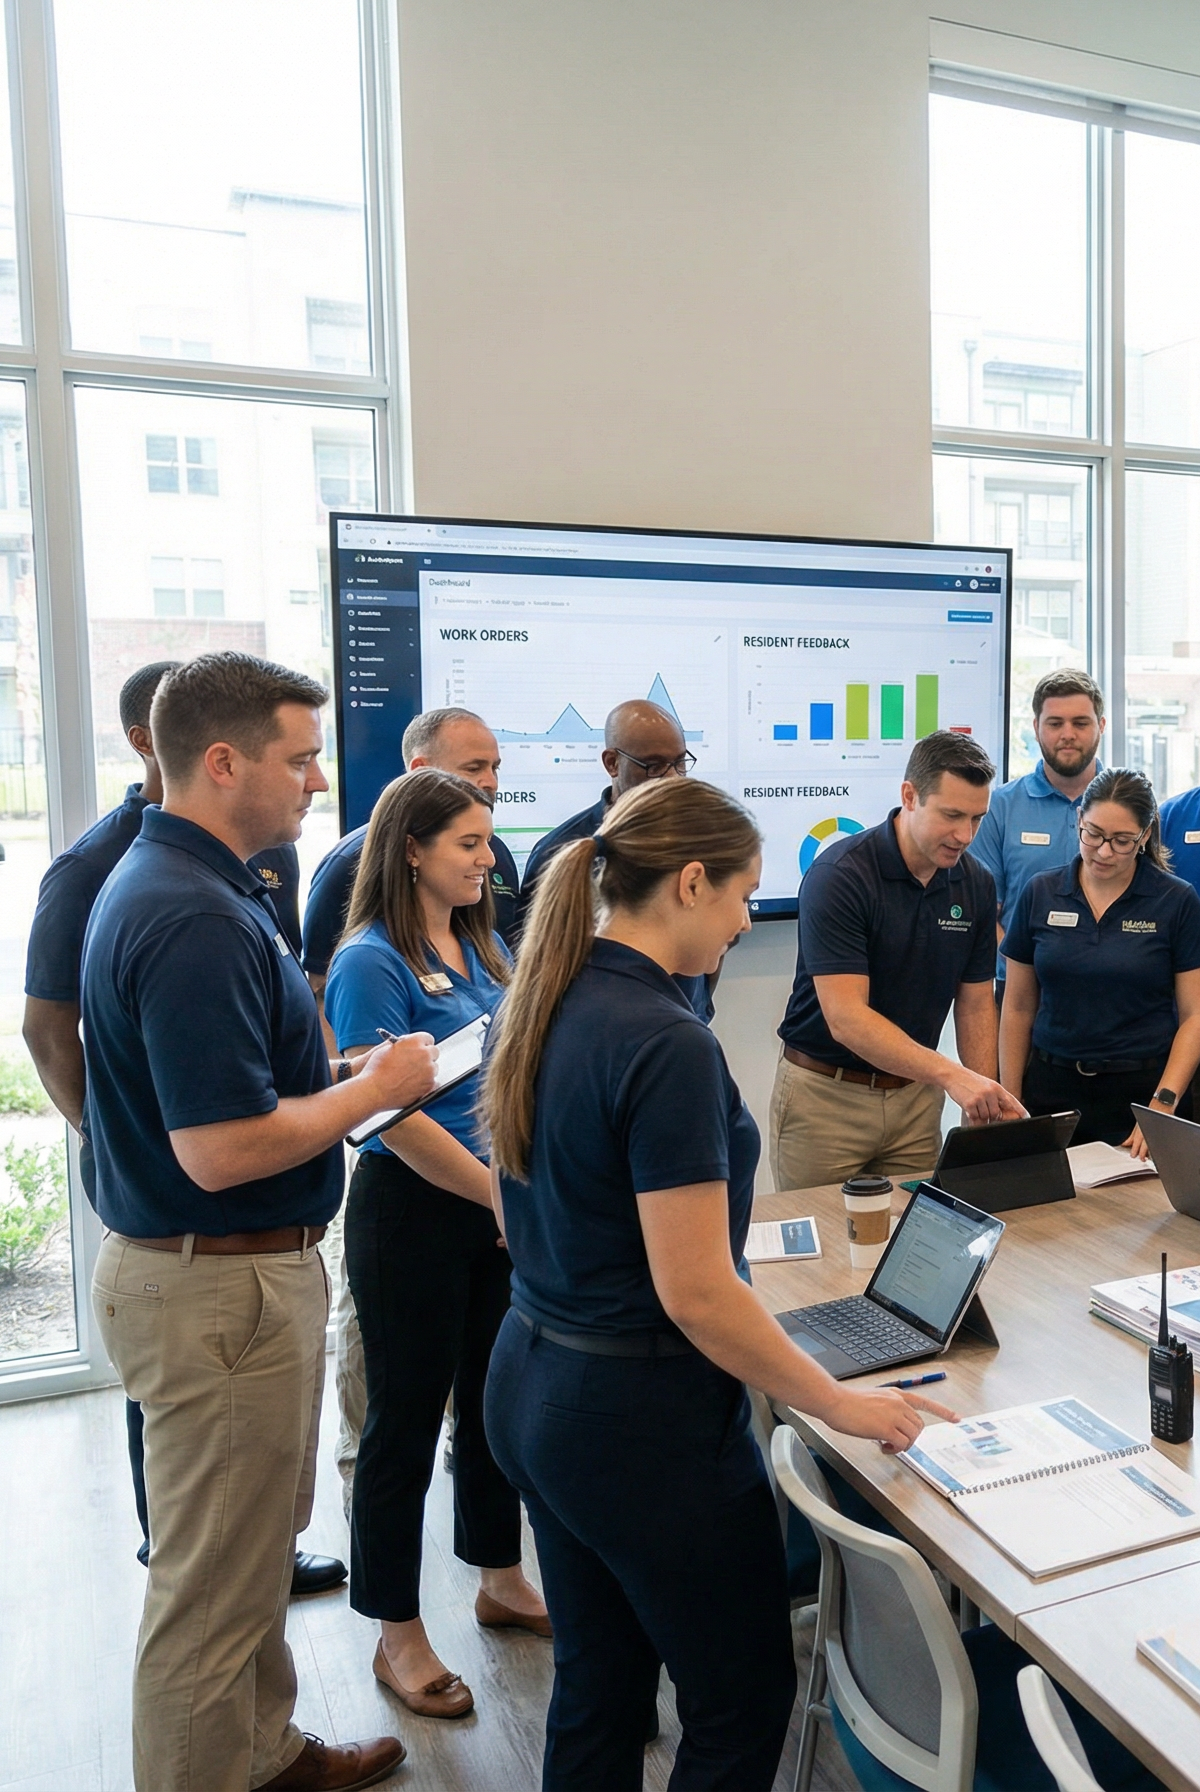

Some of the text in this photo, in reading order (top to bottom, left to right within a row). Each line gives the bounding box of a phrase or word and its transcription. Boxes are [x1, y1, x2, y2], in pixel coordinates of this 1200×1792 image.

[439, 628, 529, 643] WORK ORDERS
[743, 635, 851, 650] RESIDENT FEEDBACK
[495, 791, 537, 803] RDERS
[743, 785, 850, 799] RESIDENT FEEDBACK
